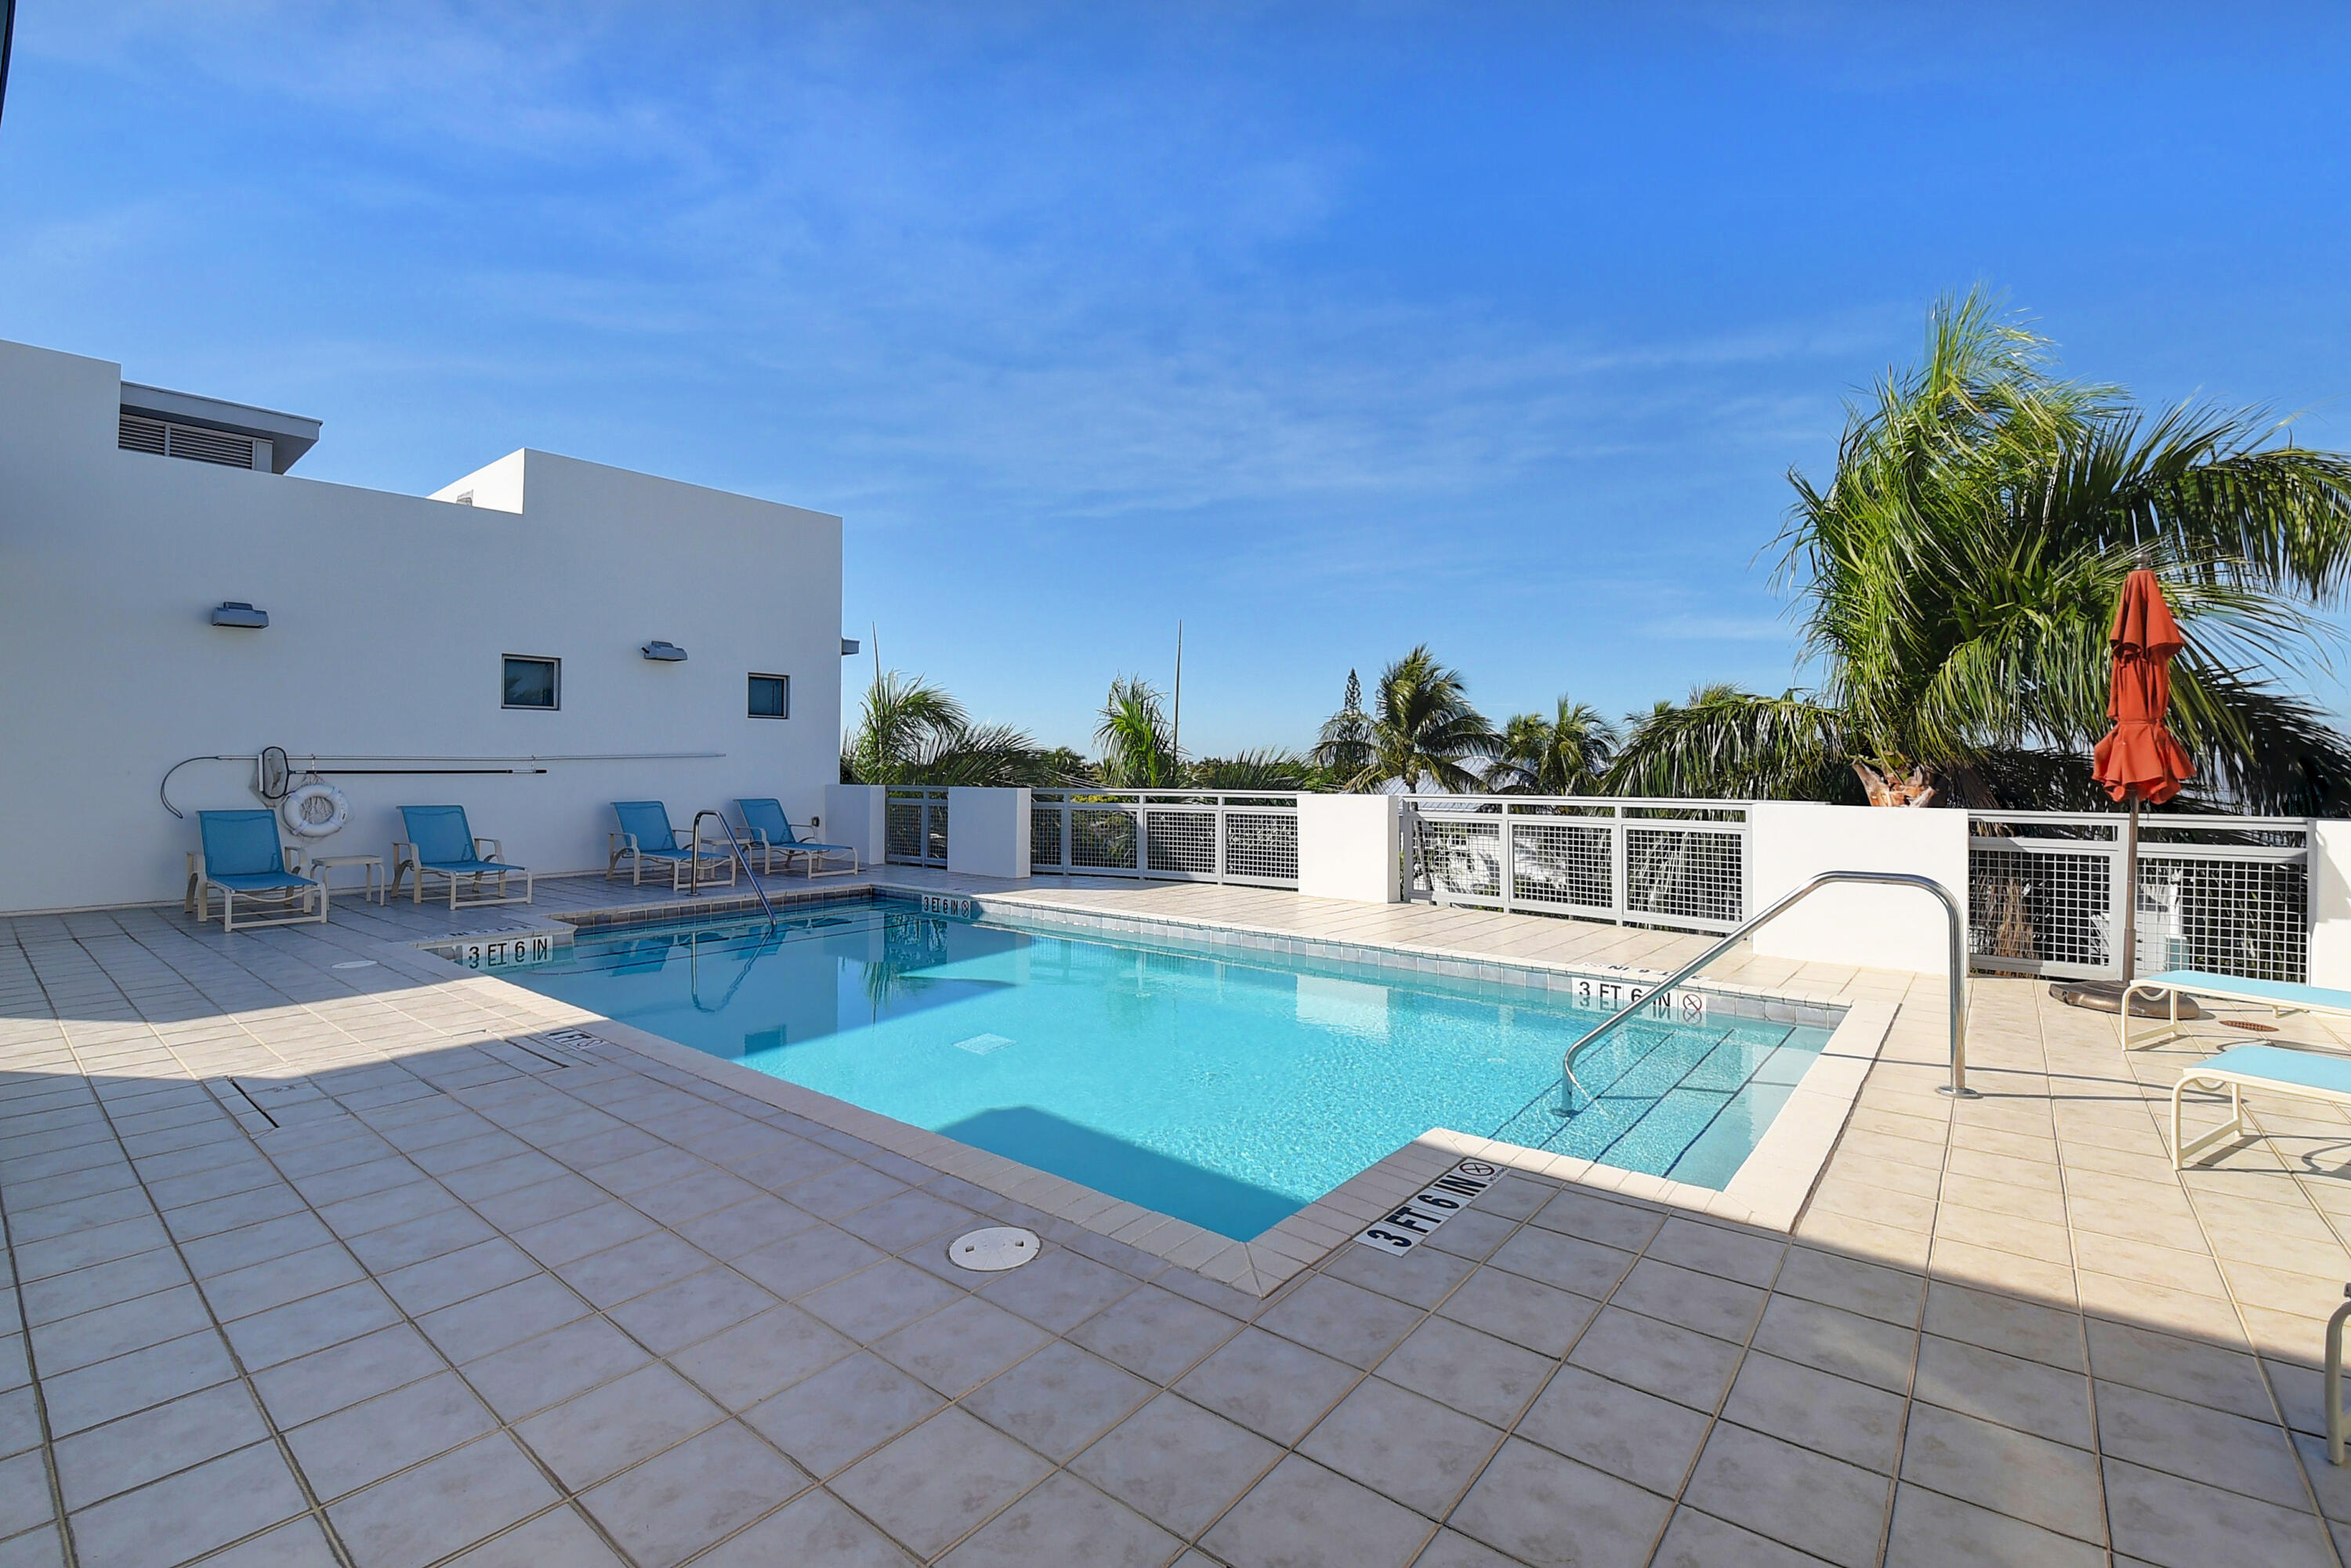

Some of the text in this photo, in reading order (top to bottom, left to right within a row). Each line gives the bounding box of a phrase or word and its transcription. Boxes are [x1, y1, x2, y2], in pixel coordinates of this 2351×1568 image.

[469, 947, 480, 961] 3
[515, 941, 525, 954] 6
[533, 938, 547, 952] IN
[1579, 981, 1591, 996] 3
[1599, 983, 1622, 1000] FT
[1367, 1174, 1488, 1248] 3 FT 6 IN
